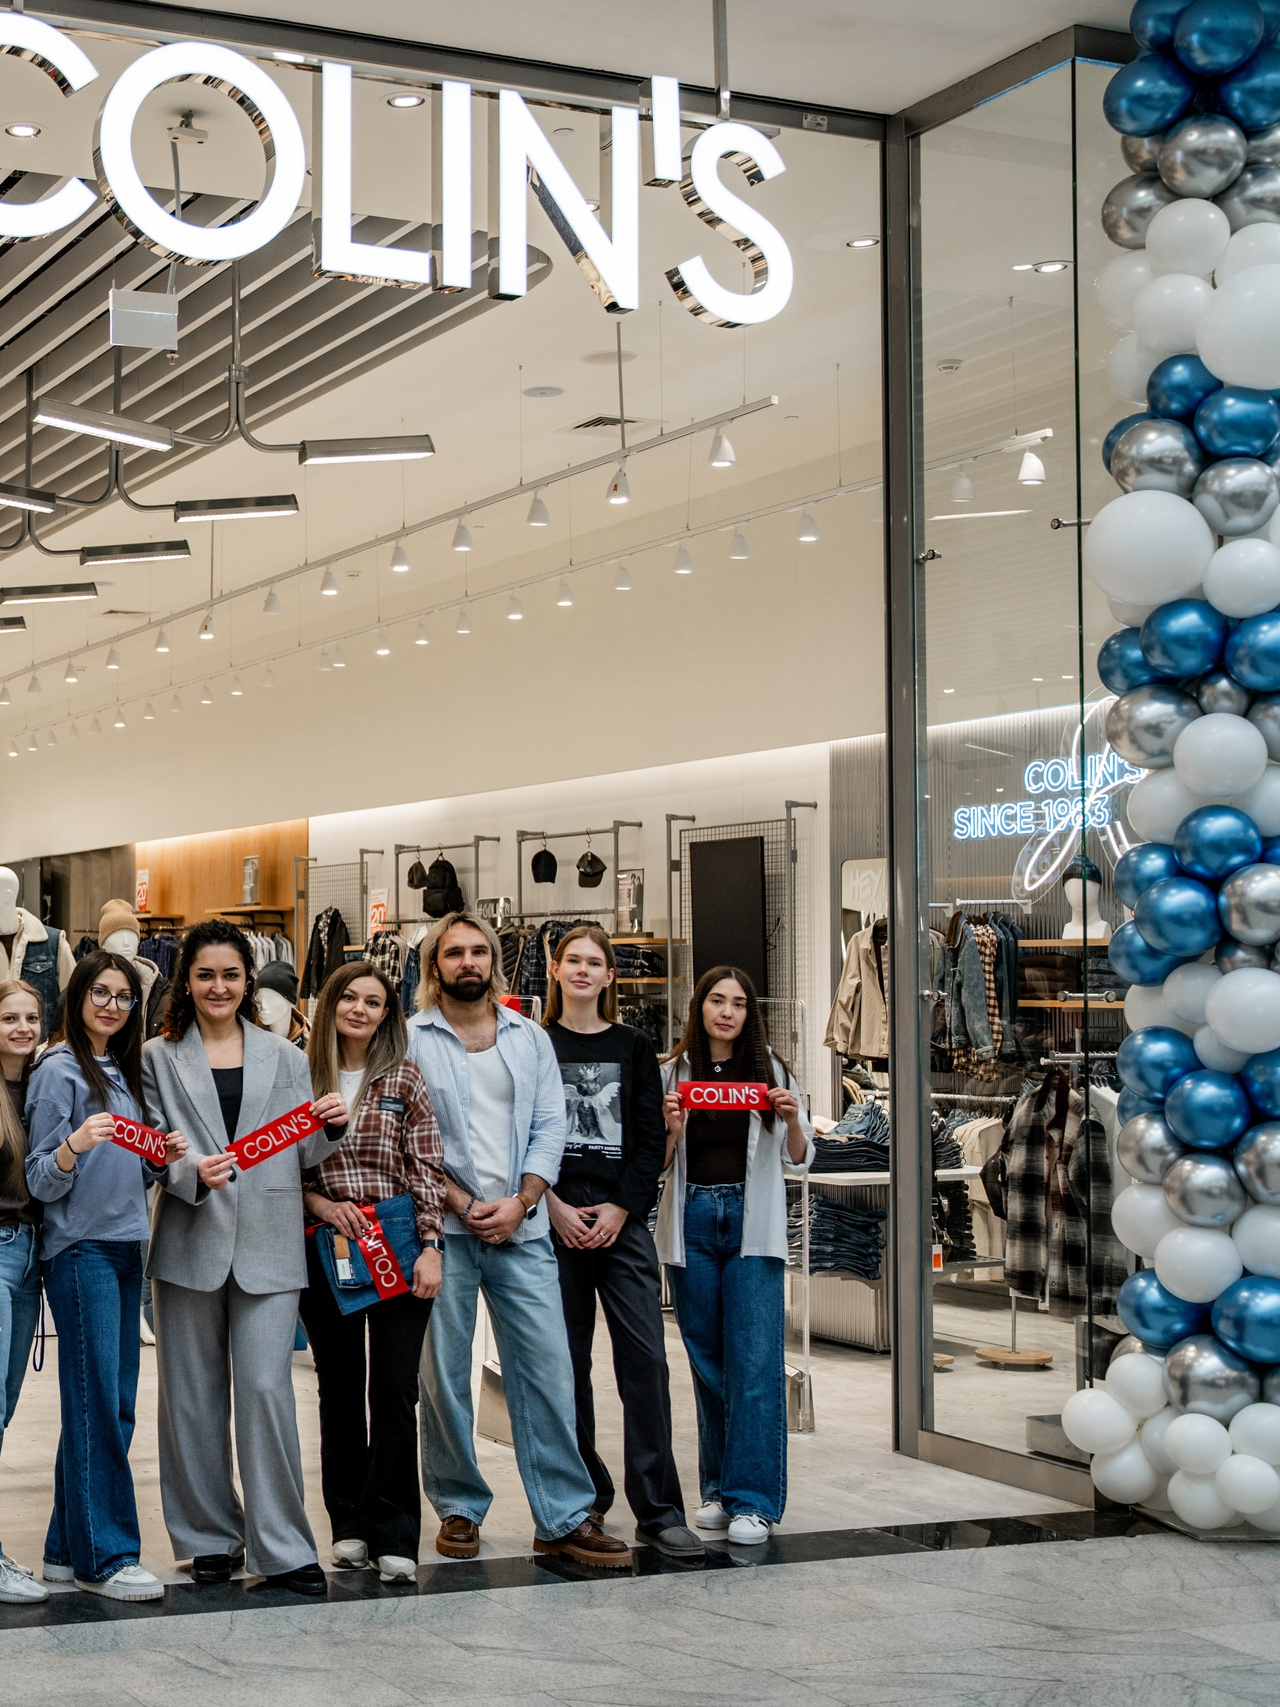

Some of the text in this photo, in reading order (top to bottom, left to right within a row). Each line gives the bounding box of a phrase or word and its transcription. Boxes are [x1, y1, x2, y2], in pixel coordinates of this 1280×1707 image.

[953, 794, 1110, 839] SINCE 1983
[690, 1086, 760, 1105] COLIN'S
[114, 1120, 167, 1159] COLIN'S
[243, 1113, 312, 1159] COLIN'S
